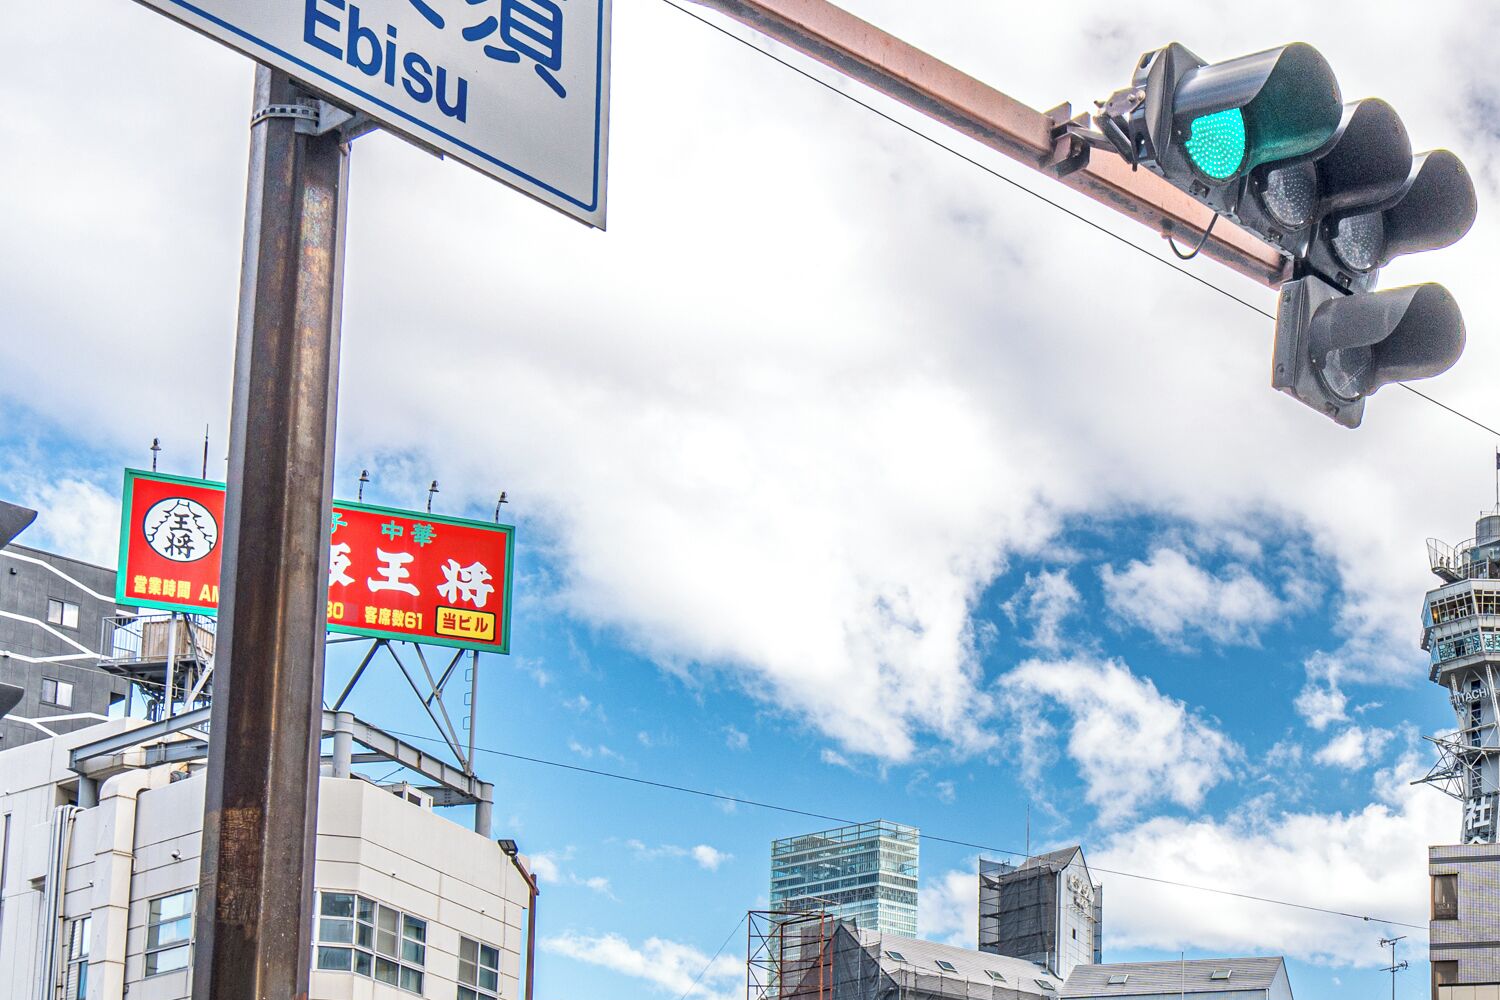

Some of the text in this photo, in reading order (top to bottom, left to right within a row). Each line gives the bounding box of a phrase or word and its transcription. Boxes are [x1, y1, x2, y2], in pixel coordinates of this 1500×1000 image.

[303, 0, 468, 124] Ebisu
[164, 512, 196, 559] 王将
[380, 519, 437, 548] 中華
[133, 574, 192, 600] 営業時間
[364, 605, 424, 630] 客席数61
[442, 611, 489, 634] 当ビル
